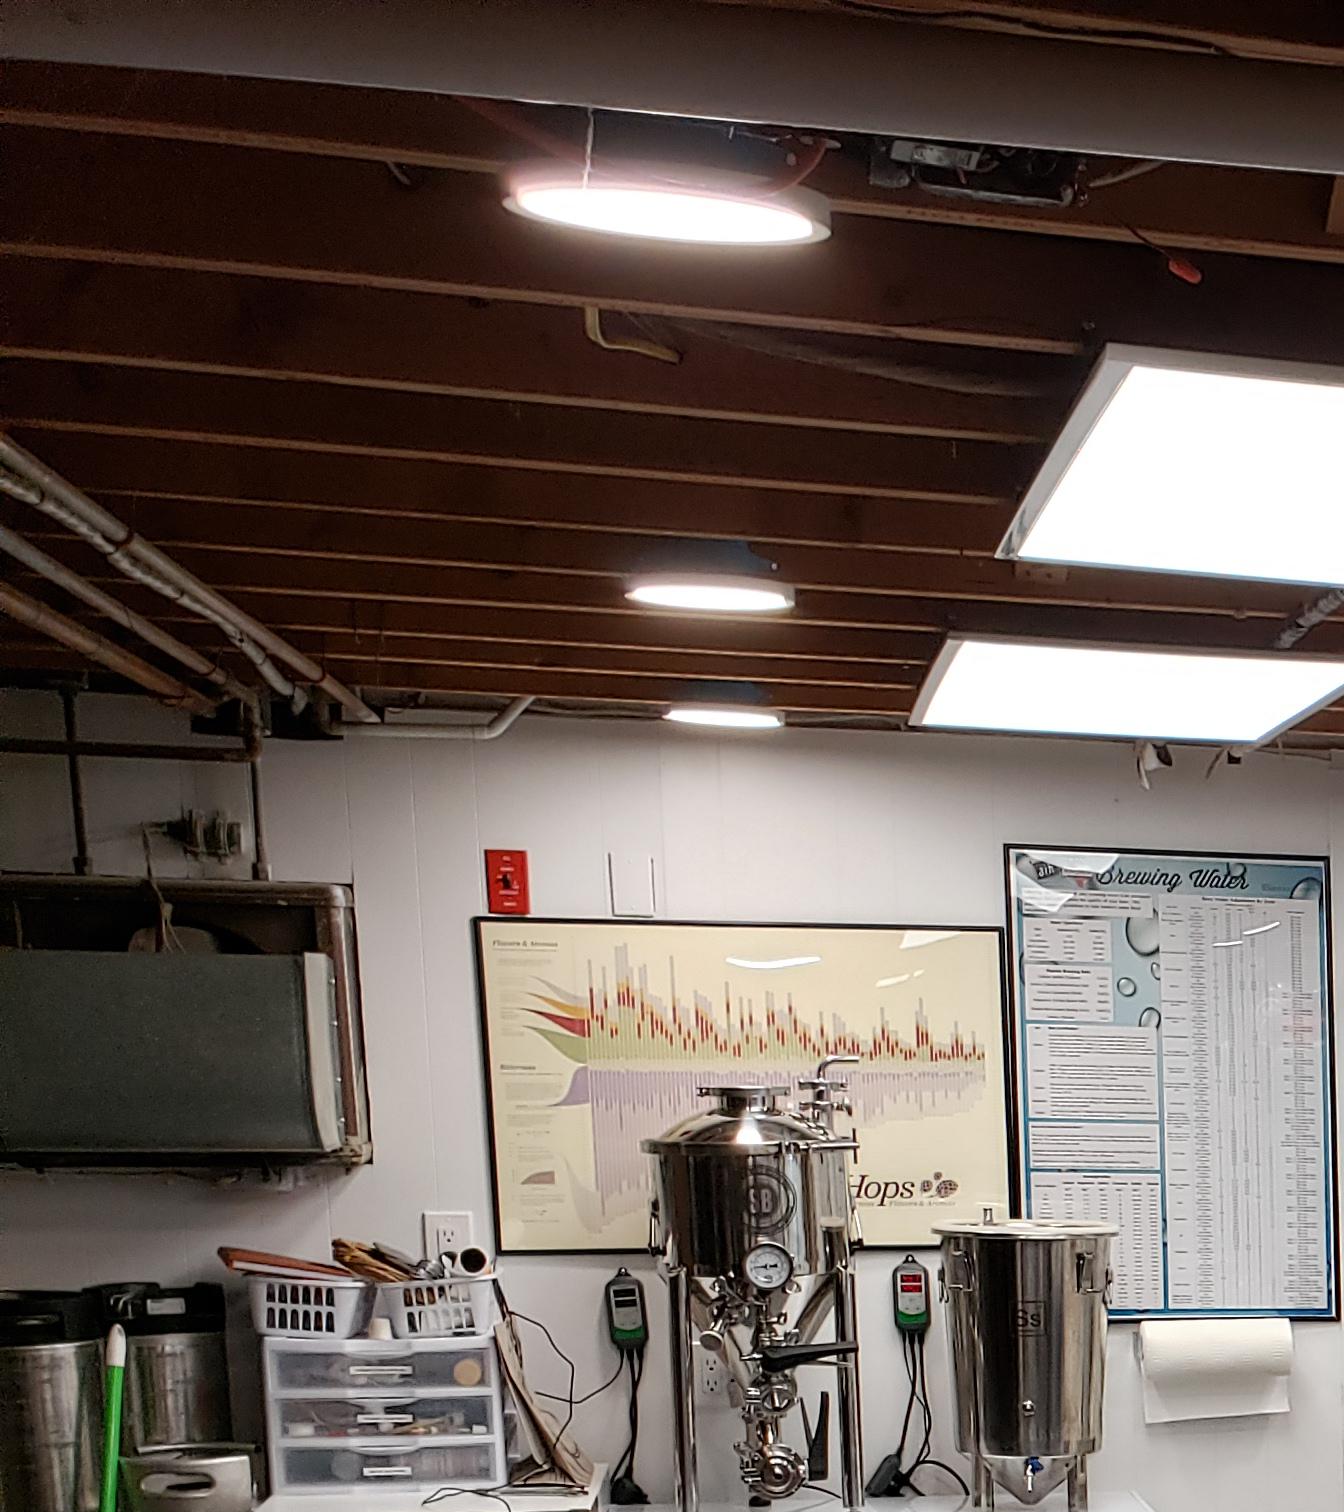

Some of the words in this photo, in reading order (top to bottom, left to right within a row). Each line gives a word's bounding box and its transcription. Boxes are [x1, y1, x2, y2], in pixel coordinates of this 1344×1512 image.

[1096, 864, 1183, 892] Brewing
[1189, 864, 1250, 889] Water
[849, 1174, 915, 1207] Hops
